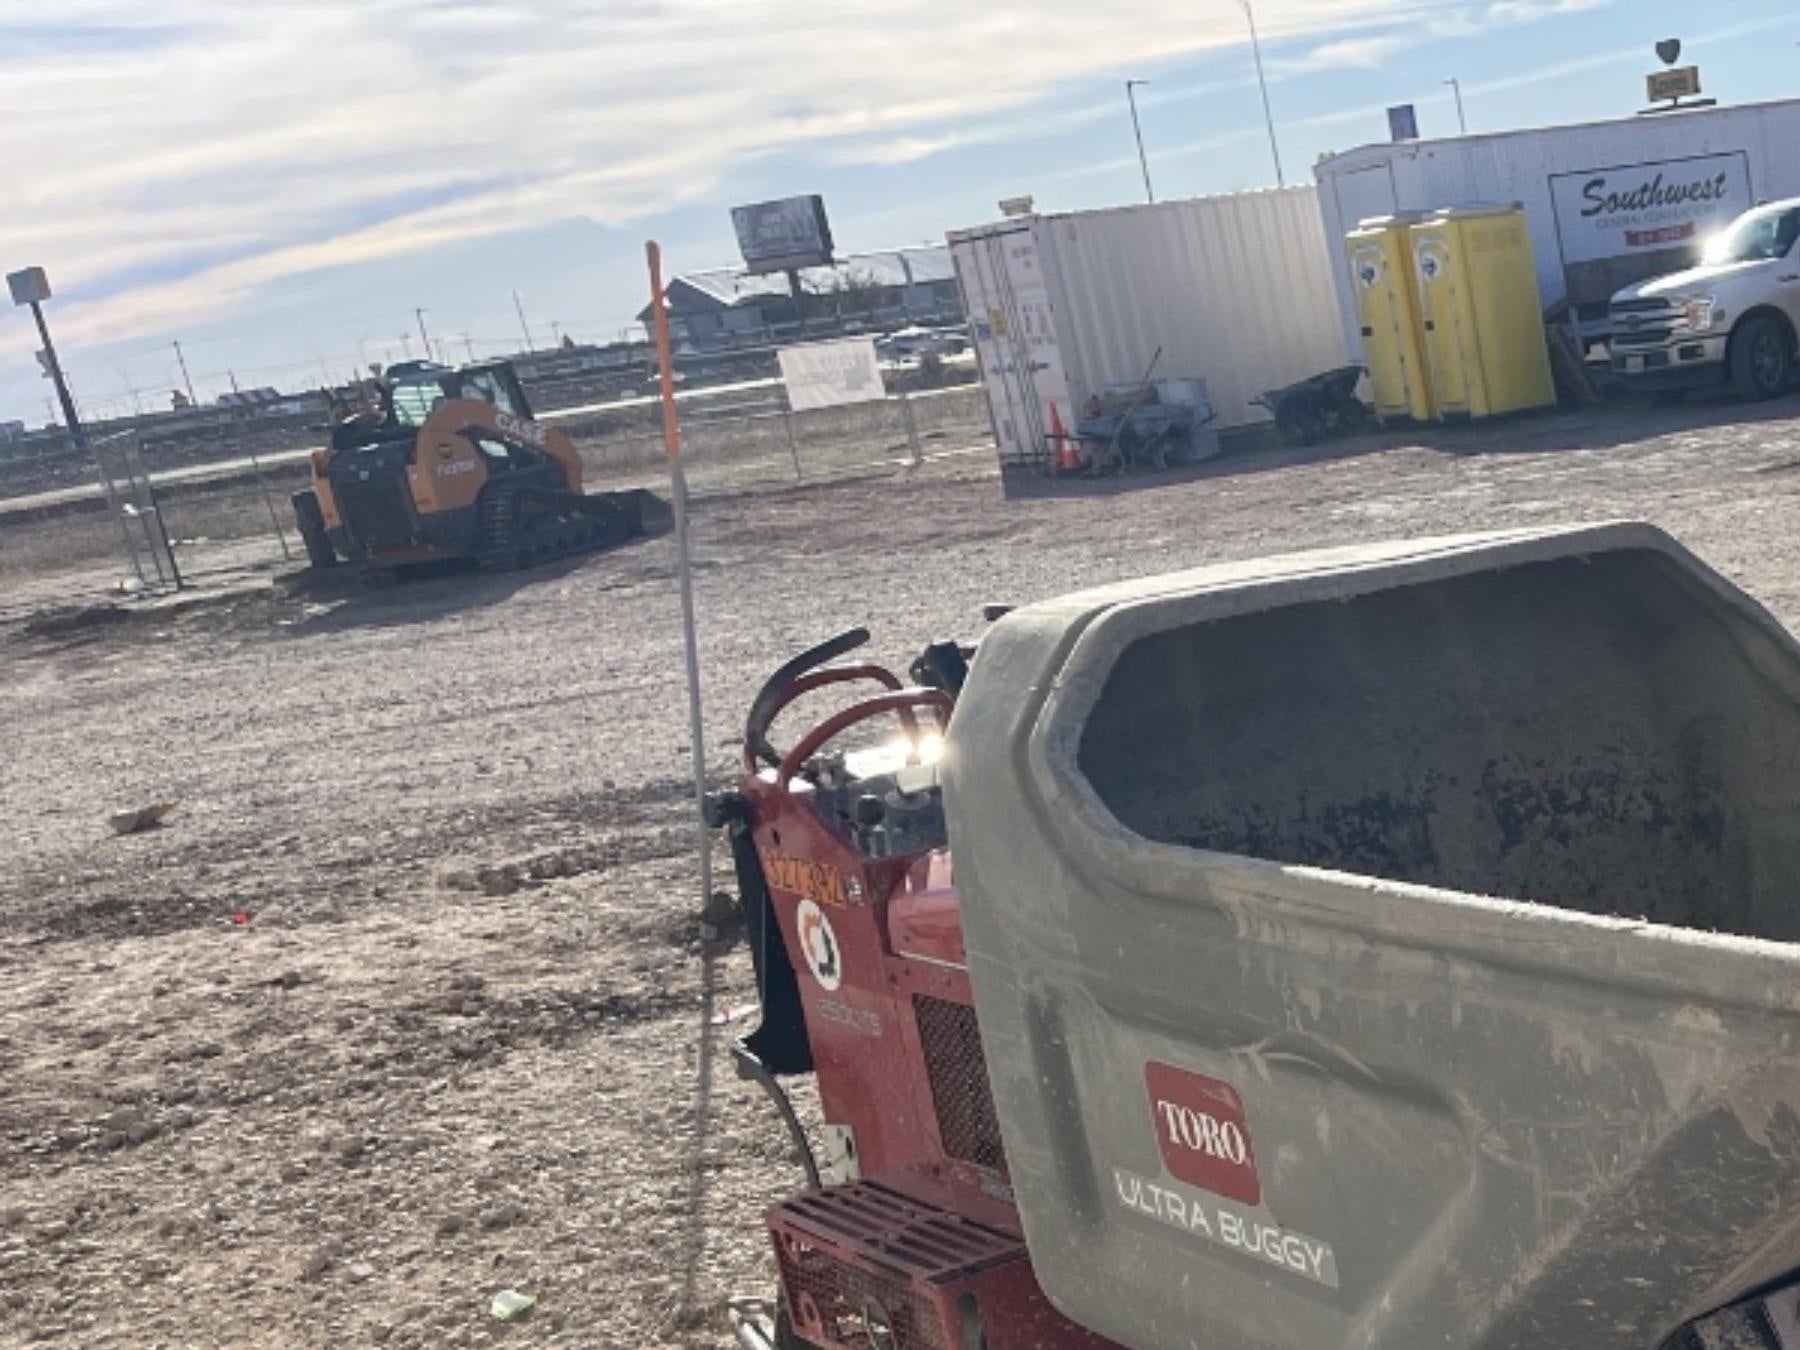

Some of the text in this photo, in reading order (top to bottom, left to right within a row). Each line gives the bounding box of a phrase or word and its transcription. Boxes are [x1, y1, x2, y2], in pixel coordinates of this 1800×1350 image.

[1580, 171, 1727, 217] Southwest
[495, 413, 547, 446] CASE
[1157, 1099, 1246, 1165] TORO
[1115, 1171, 1324, 1277] ULTRA BUGGY
